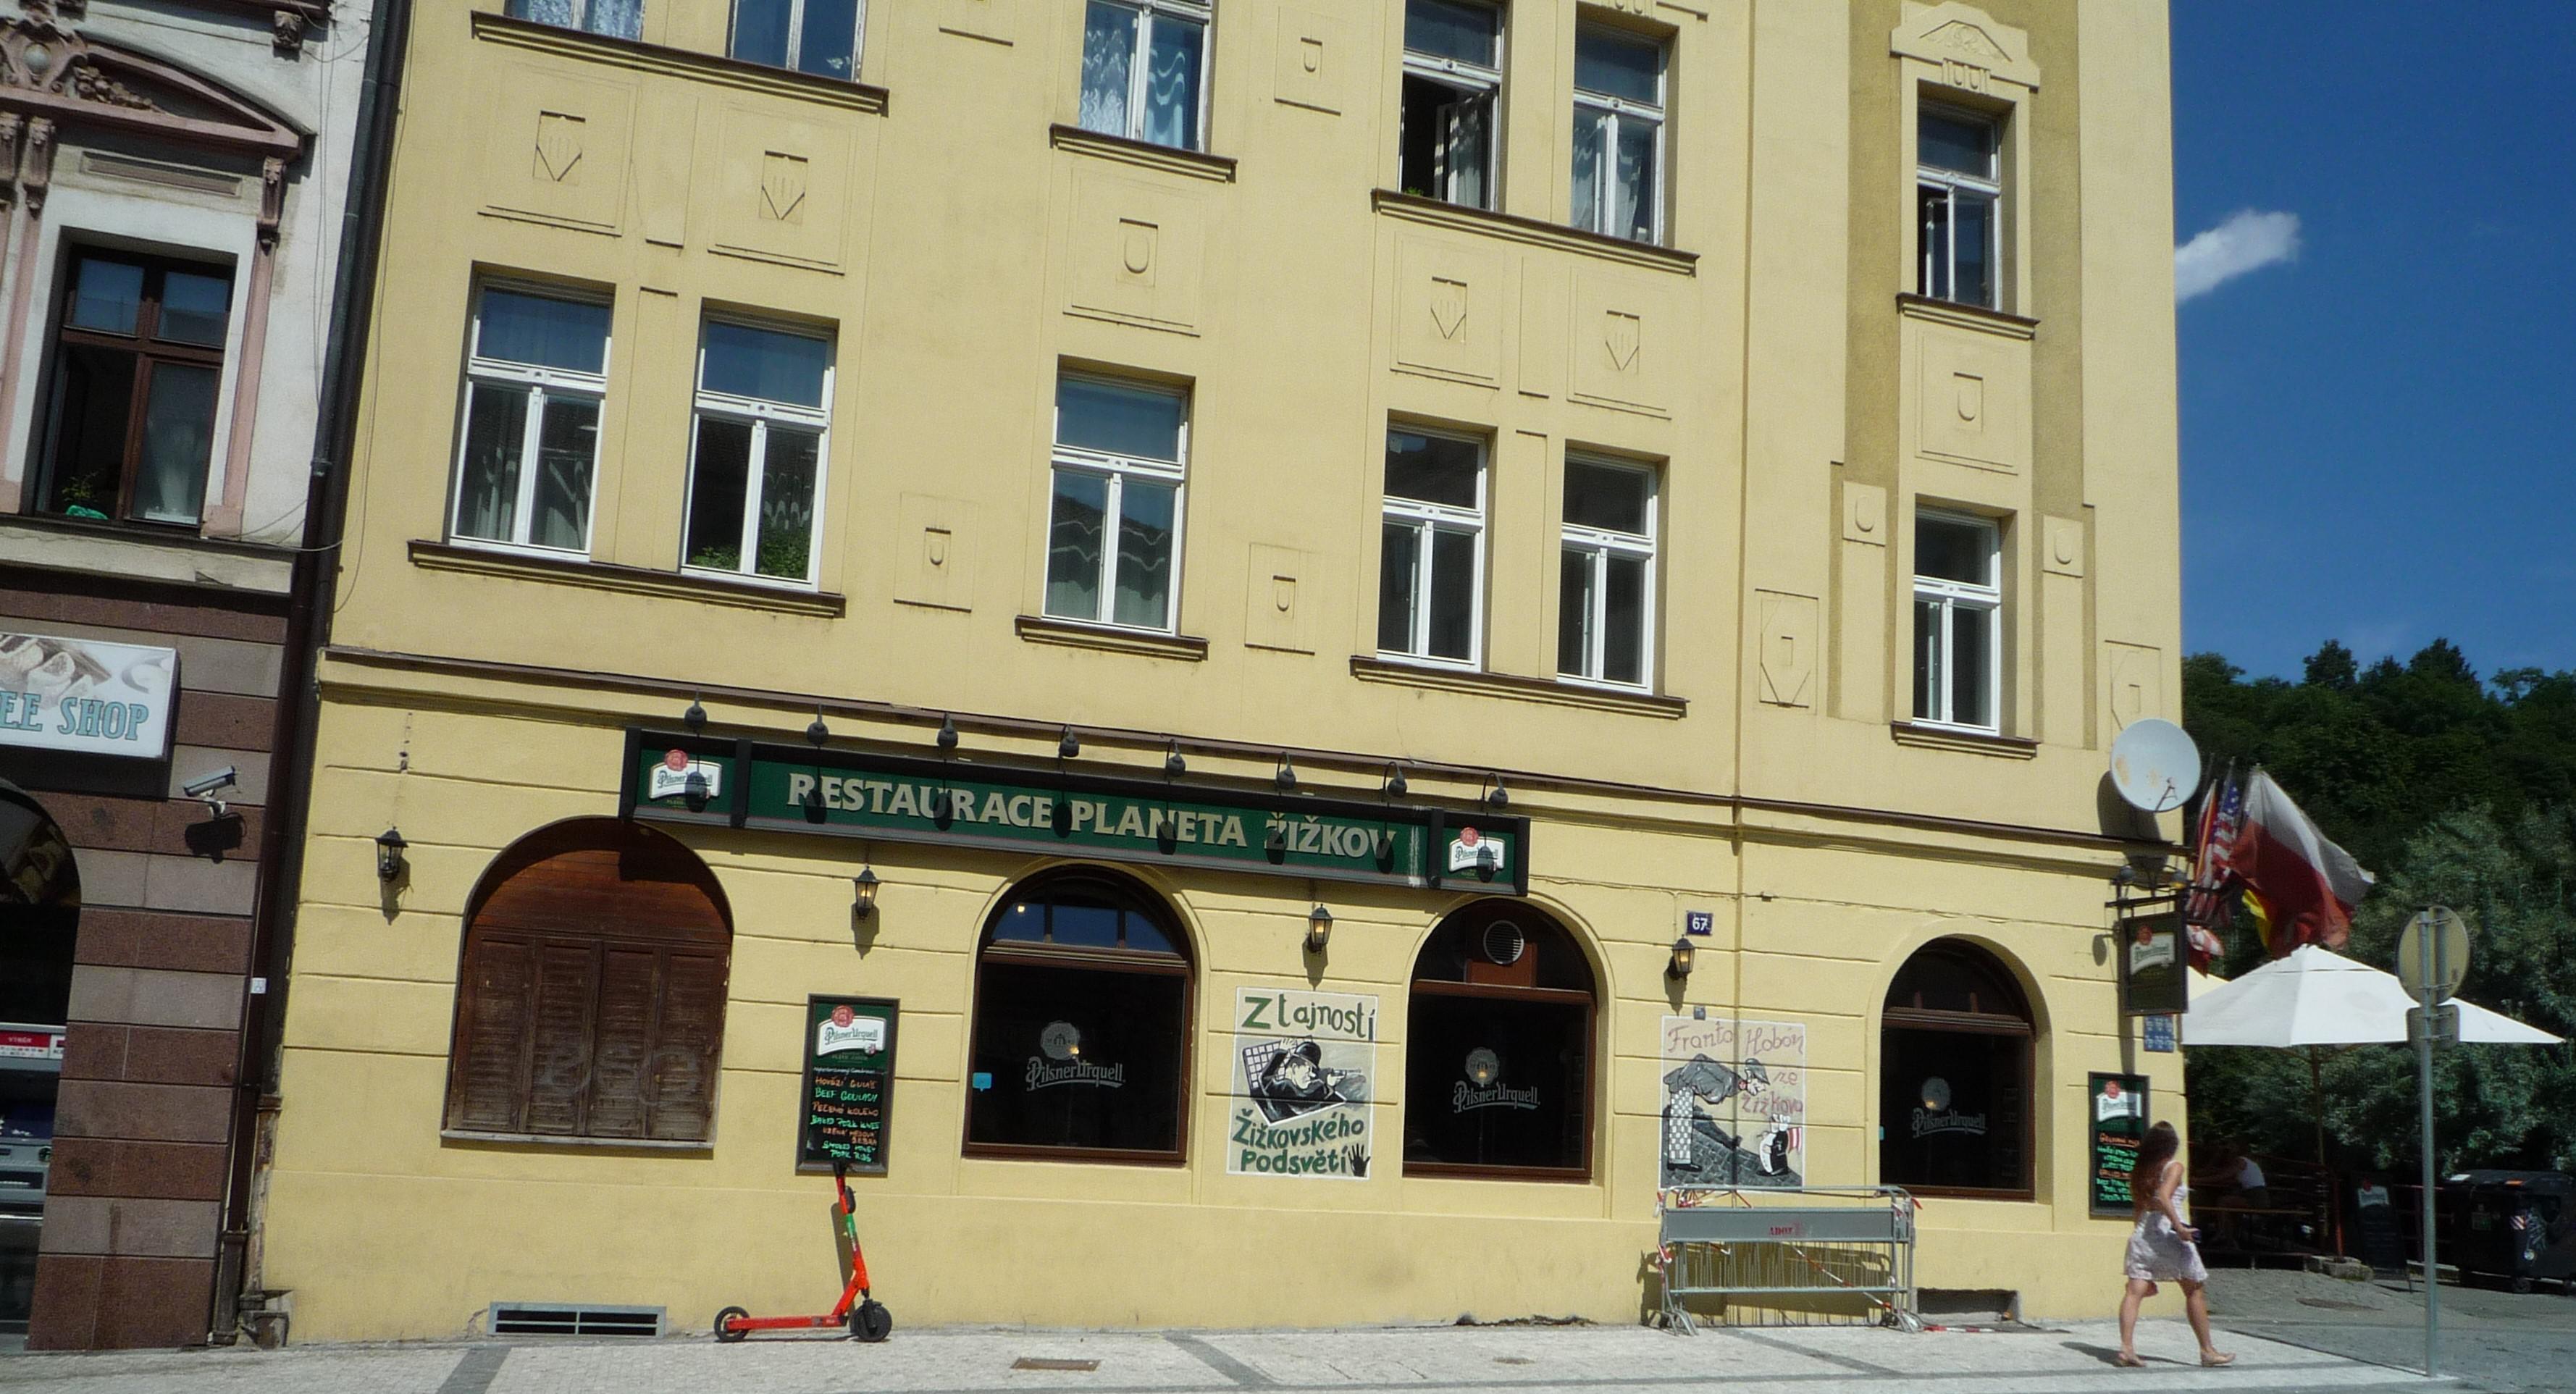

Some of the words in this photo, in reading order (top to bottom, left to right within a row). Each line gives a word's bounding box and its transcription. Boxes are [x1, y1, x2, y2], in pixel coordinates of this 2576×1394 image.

[56, 697, 149, 741] SHOP
[787, 772, 1053, 828] RESTAURACE
[1070, 799, 1248, 847] PLANETA
[1264, 814, 1397, 858] ŽIŽKOV
[1692, 917, 1708, 931] 67
[1241, 996, 1273, 1030] Z
[824, 1026, 852, 1046] Pilsner
[851, 1027, 878, 1040] Urquell
[1025, 1056, 1077, 1092] Pilsner
[1075, 1057, 1123, 1088] Urquell
[1452, 1080, 1498, 1114] Pilsner
[1495, 1081, 1538, 1109] Urquell
[1232, 1108, 1364, 1151] Žižkovského
[1911, 1107, 1950, 1138] Pilsner
[1948, 1108, 1986, 1134] Urquell
